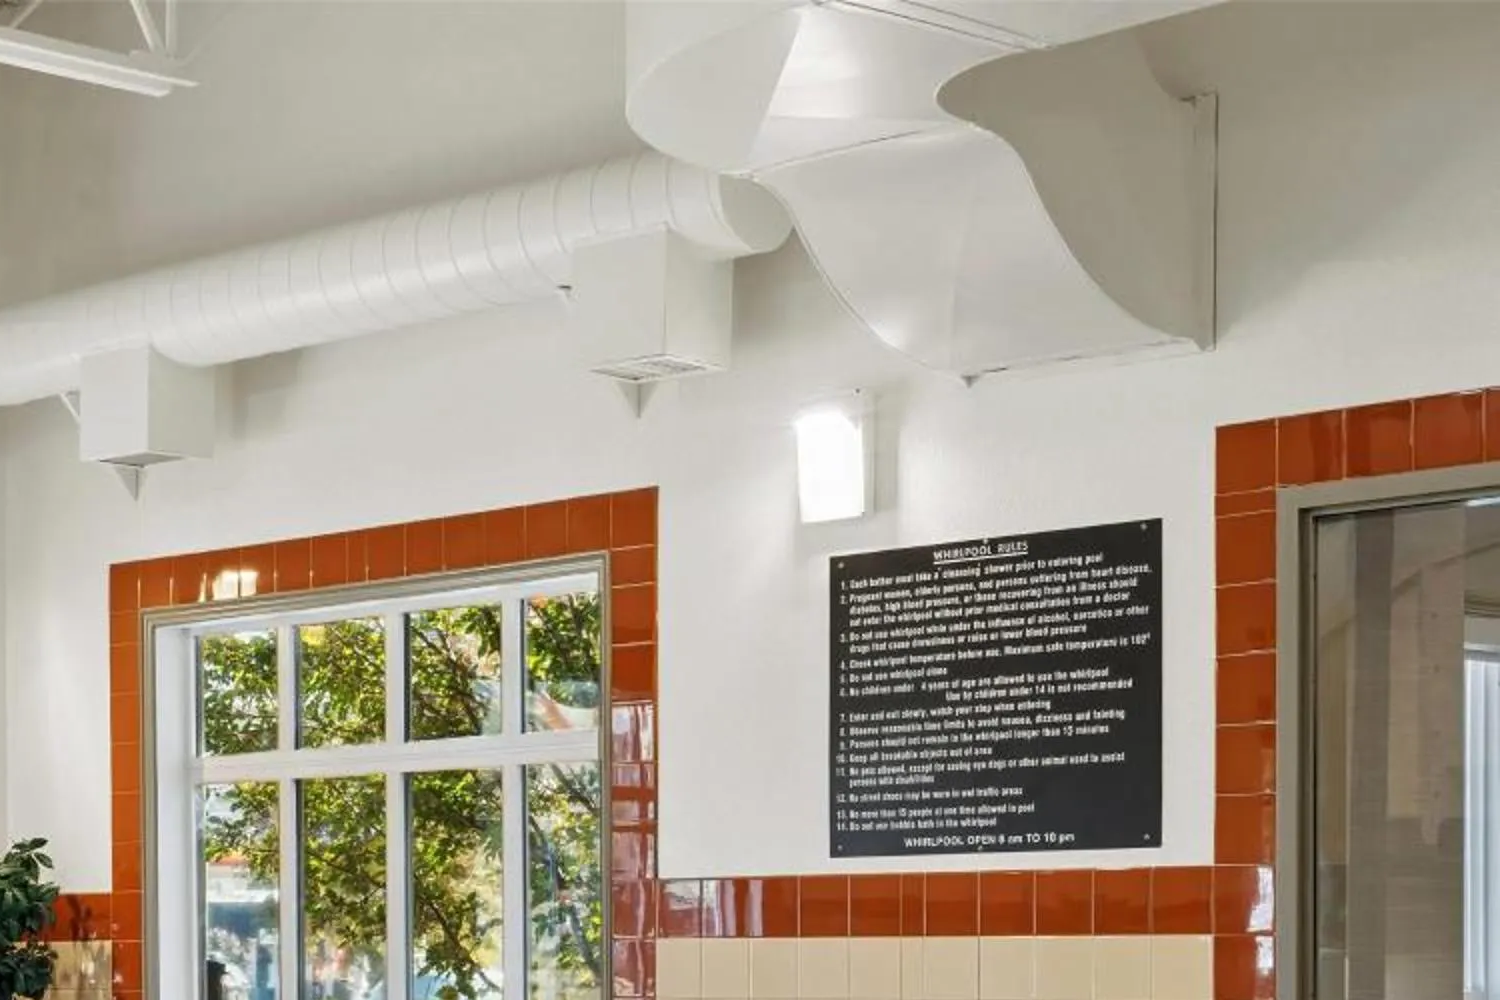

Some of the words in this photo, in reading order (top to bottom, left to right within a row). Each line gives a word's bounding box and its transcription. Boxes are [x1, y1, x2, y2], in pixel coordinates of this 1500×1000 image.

[933, 544, 991, 560] WHIRLPOOL
[997, 540, 1027, 553] RULES
[903, 835, 963, 847] WHIRLPOOL
[967, 834, 995, 844] OPEN
[1026, 832, 1040, 842] TO
[1044, 832, 1055, 842] 10
[1058, 833, 1074, 842] pm
